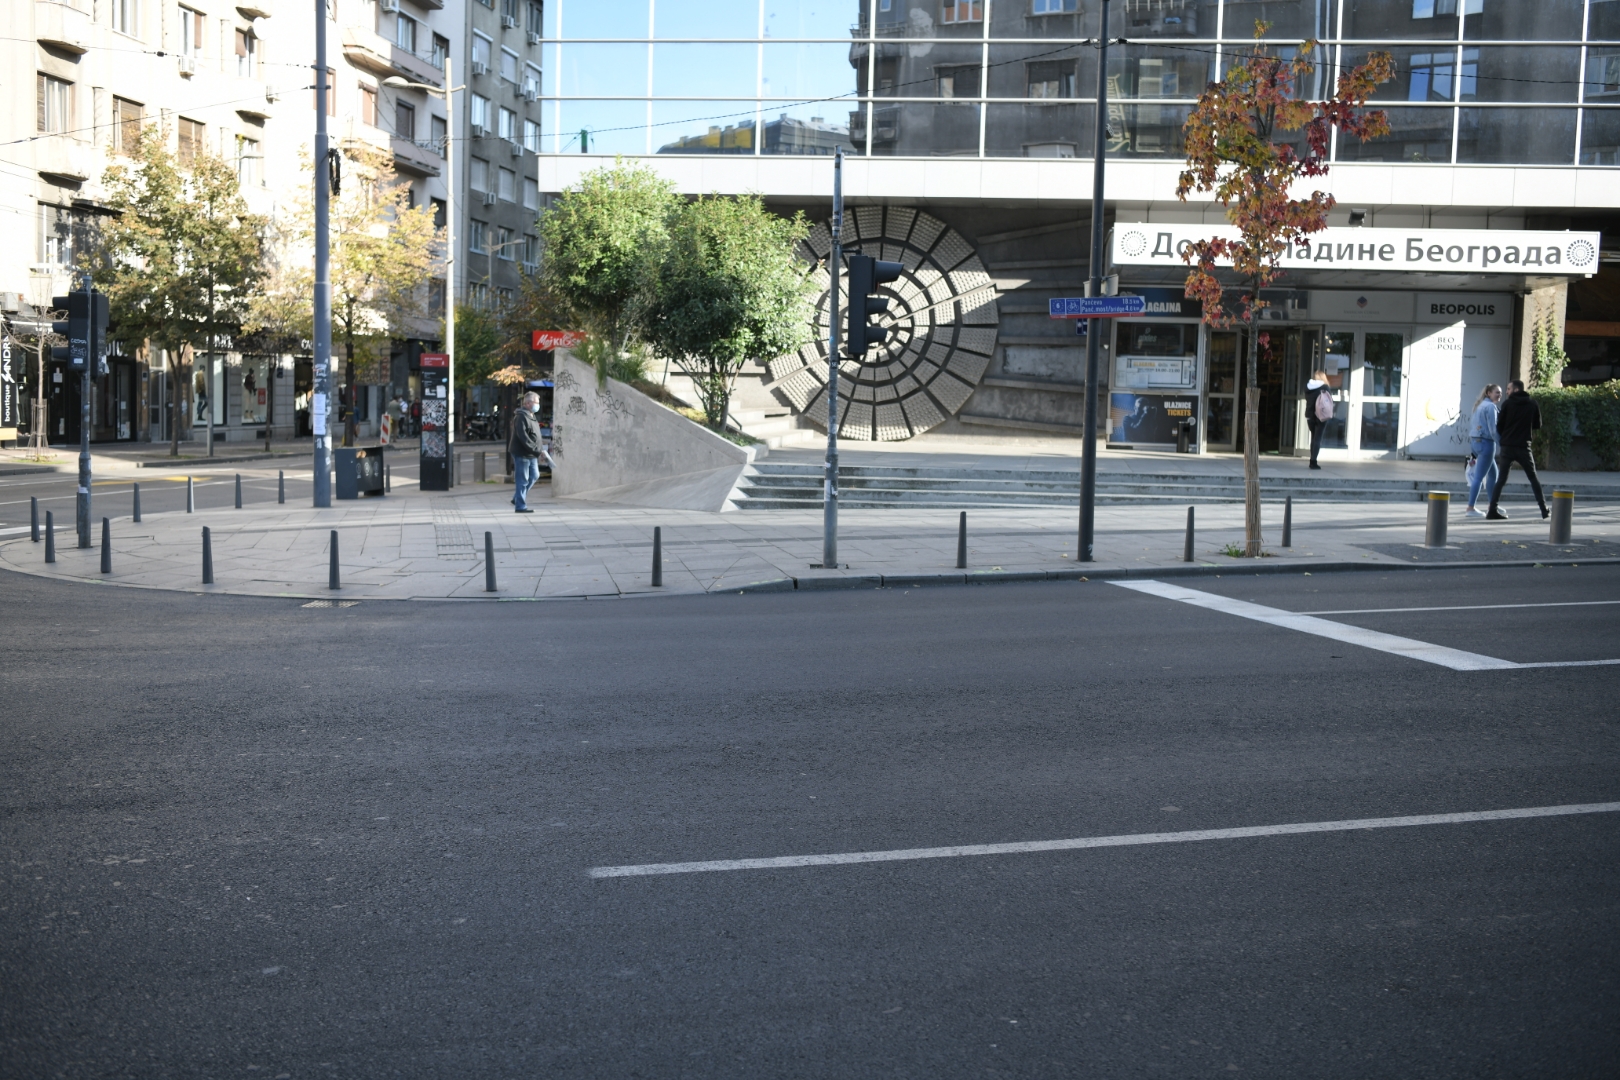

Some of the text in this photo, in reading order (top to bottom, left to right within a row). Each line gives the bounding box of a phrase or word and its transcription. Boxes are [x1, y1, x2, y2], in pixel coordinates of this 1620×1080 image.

[1151, 232, 1219, 259] До
[1406, 238, 1562, 267] Београда
[1144, 302, 1181, 313] LAGAJNA
[1431, 304, 1495, 315] BEOPOLIS
[4, 385, 12, 422] boutique
[1164, 401, 1192, 409] ULAZNICE
